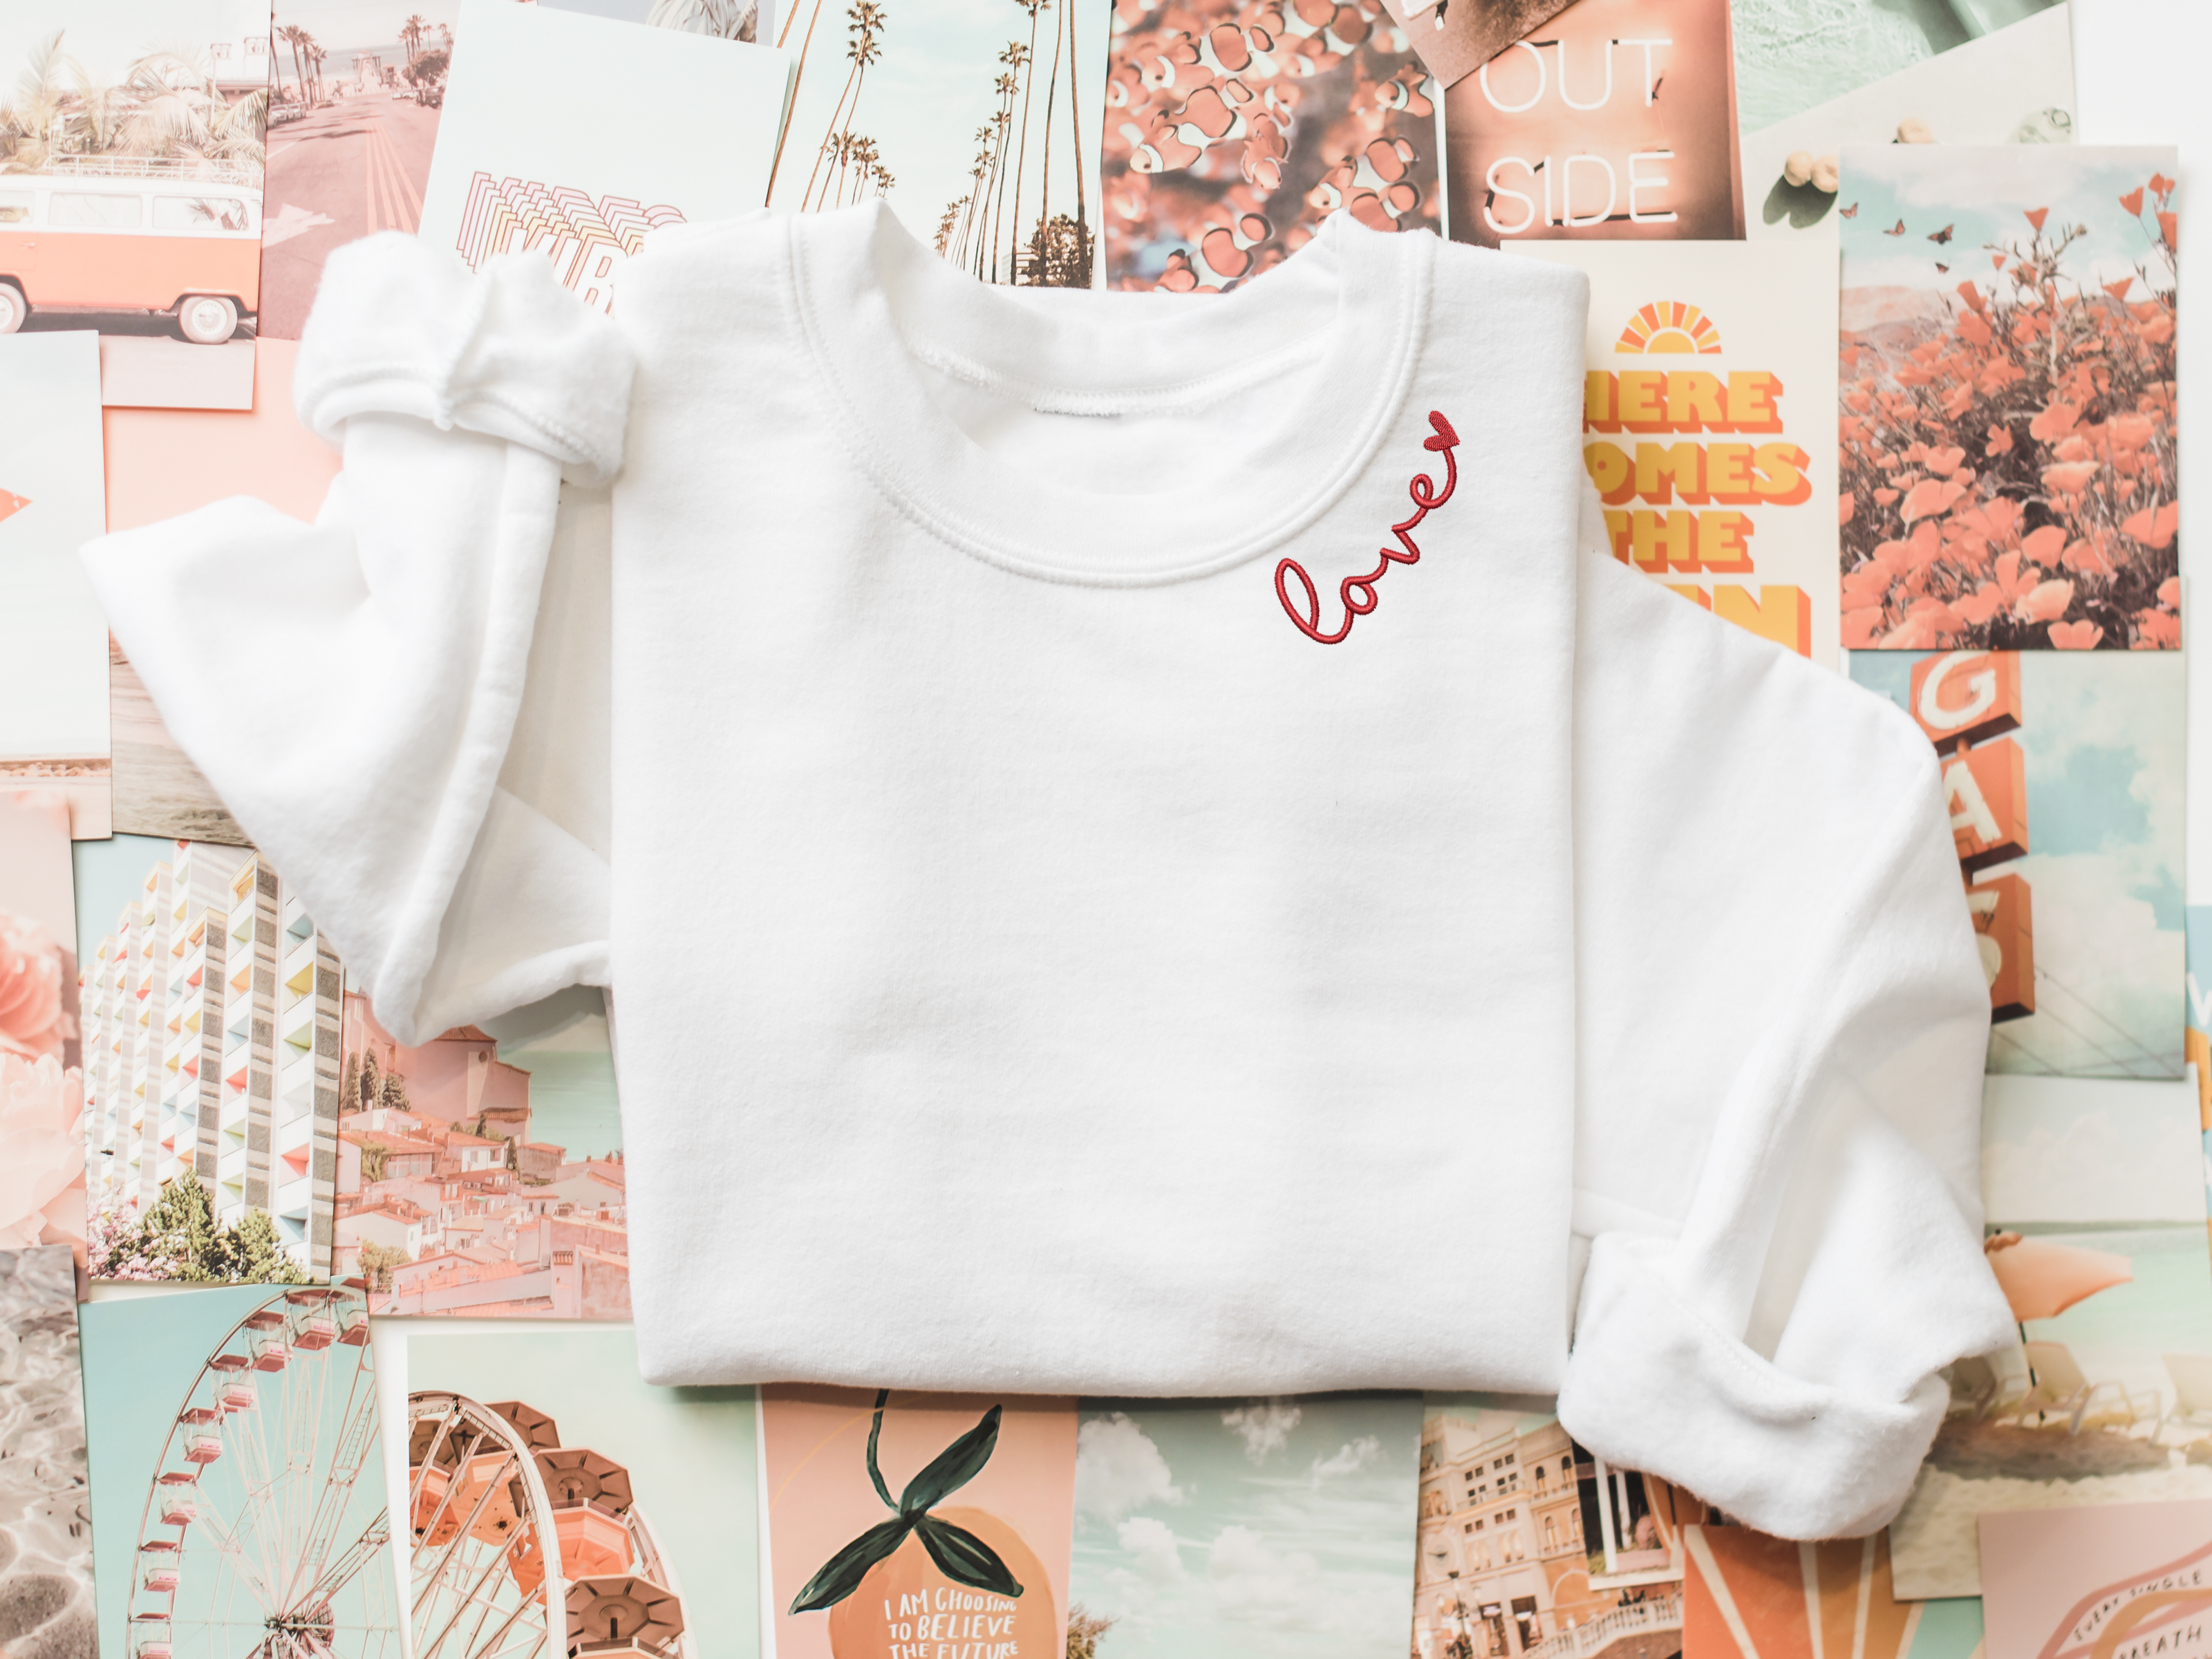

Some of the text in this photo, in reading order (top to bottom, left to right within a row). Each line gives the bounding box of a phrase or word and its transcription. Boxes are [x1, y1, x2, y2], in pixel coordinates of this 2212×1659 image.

[1480, 39, 1674, 113] OUT
[1483, 151, 1678, 234] SIDE
[1582, 441, 1812, 506] OMES
[1275, 447, 1457, 644] love
[884, 1586, 1018, 1621] I AM CHOOSING
[2130, 1568, 2203, 1597] SINGLE
[888, 1613, 1017, 1641] TO BELIEVE
[888, 1642, 930, 1659] THE
